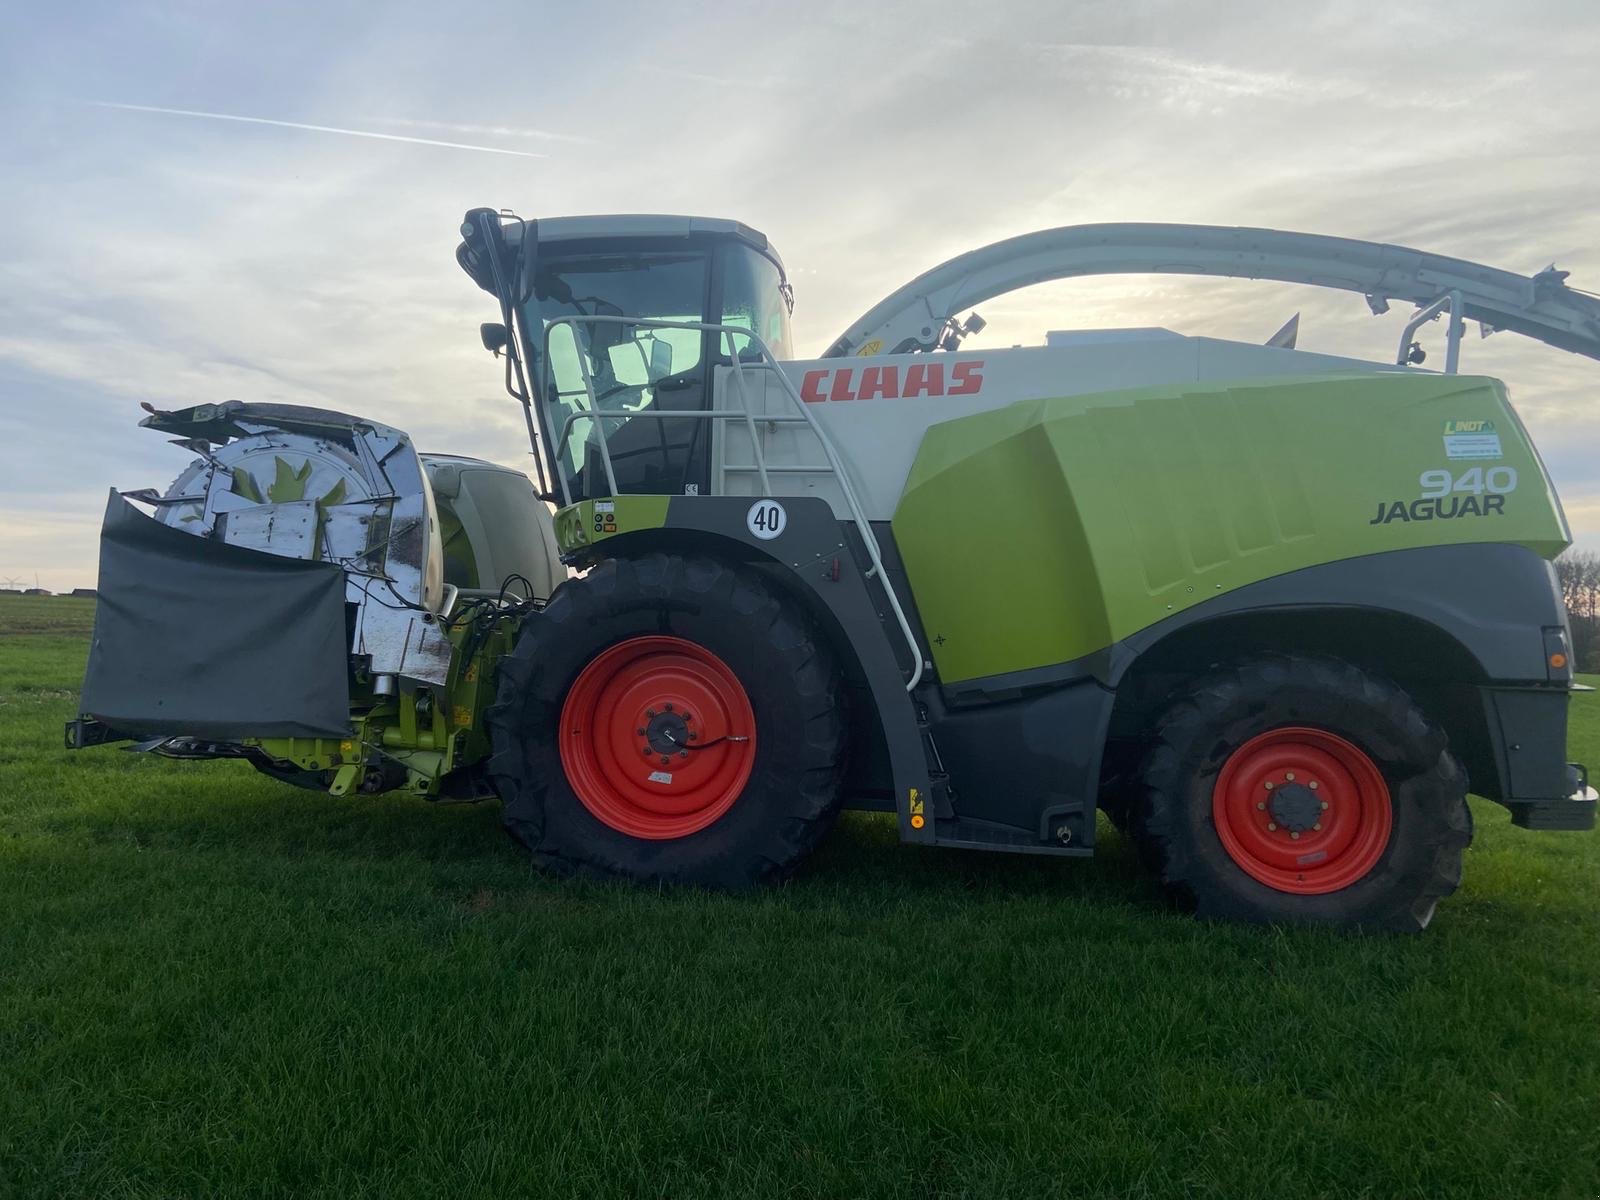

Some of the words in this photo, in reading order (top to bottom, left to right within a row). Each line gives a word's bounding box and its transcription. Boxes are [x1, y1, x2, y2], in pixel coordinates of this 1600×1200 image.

[800, 361, 985, 403] CLAAS
[1419, 466, 1518, 498] 940
[753, 506, 780, 532] 40
[1370, 494, 1506, 525] JAGUAR
